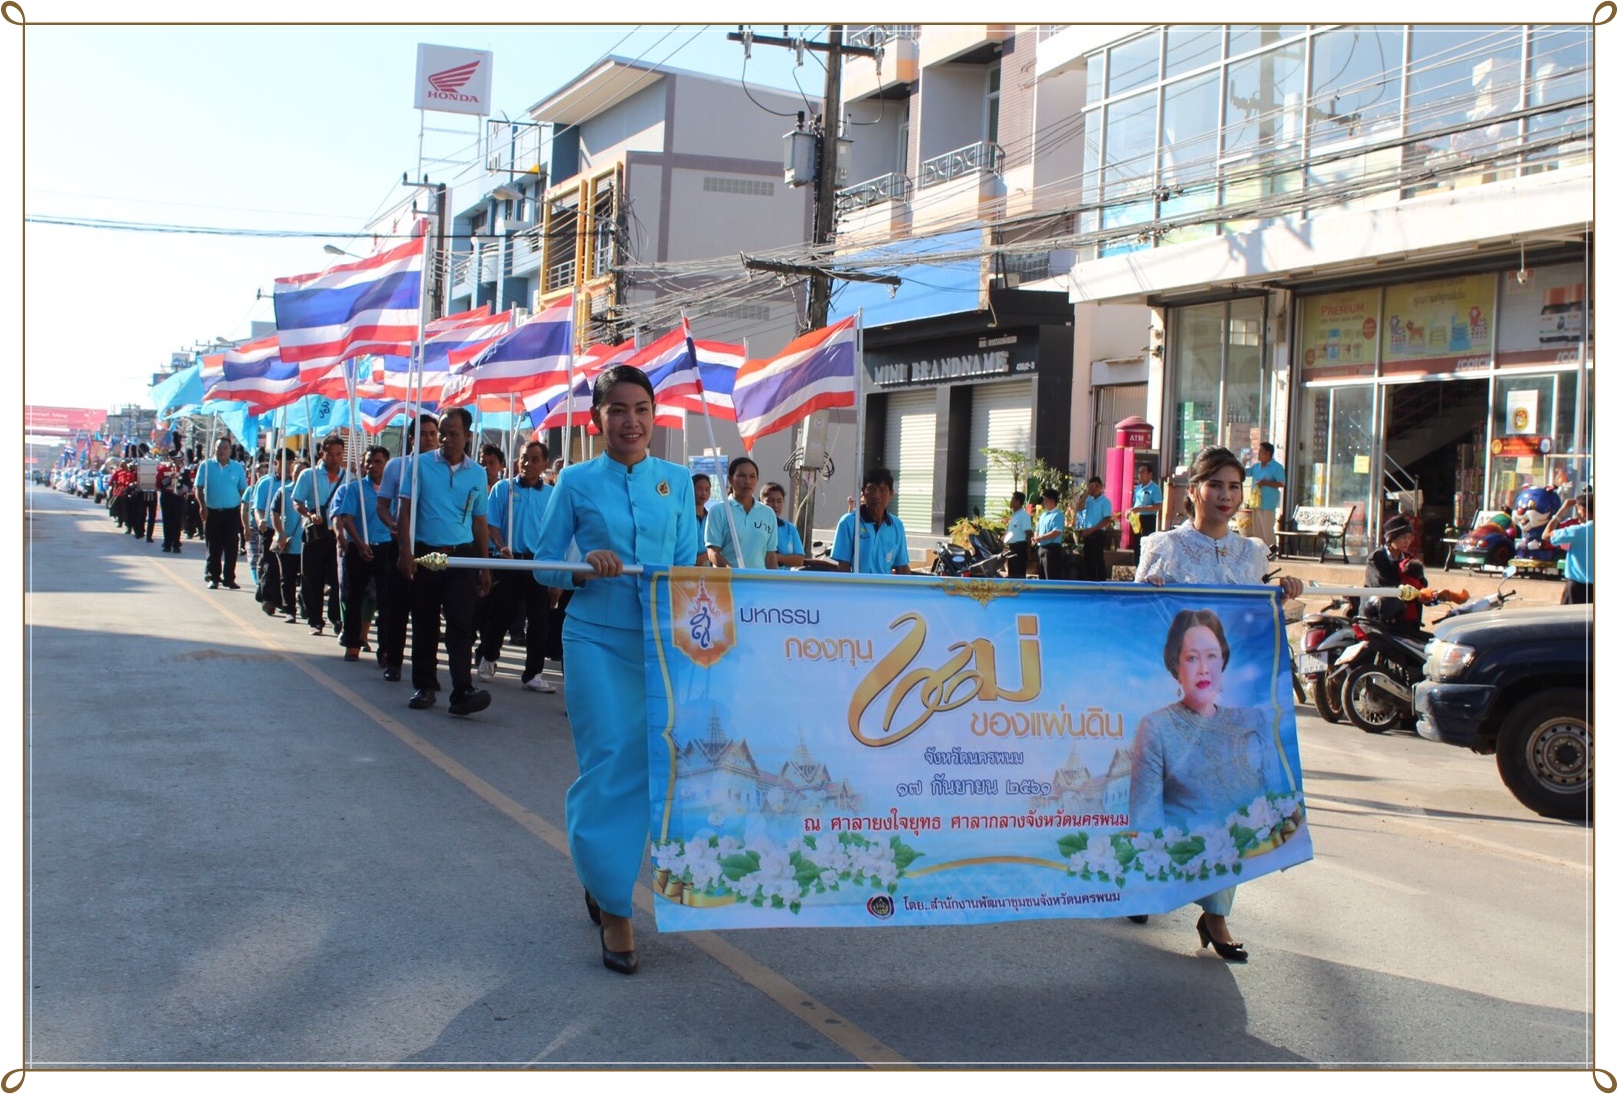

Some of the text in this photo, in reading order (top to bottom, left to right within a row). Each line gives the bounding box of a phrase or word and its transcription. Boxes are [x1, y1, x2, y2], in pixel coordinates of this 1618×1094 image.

[428, 91, 479, 103] HONDA
[1321, 303, 1365, 316] PREMIUM
[874, 351, 1009, 385] MINI BRANDNAME
[1130, 434, 1144, 442] ATM
[739, 606, 821, 625] มหกรรม
[784, 637, 874, 667] กองทุน
[970, 704, 1124, 738] ของแผ่นดิน
[924, 746, 1024, 766] จังหวัดนครพนม
[896, 773, 1052, 797] ๑๗ กันยายน ๒๕๖๑
[804, 808, 1131, 837] ณ ศาลายงใจยุทธ ศาลากลางจังหวัดนครพนม
